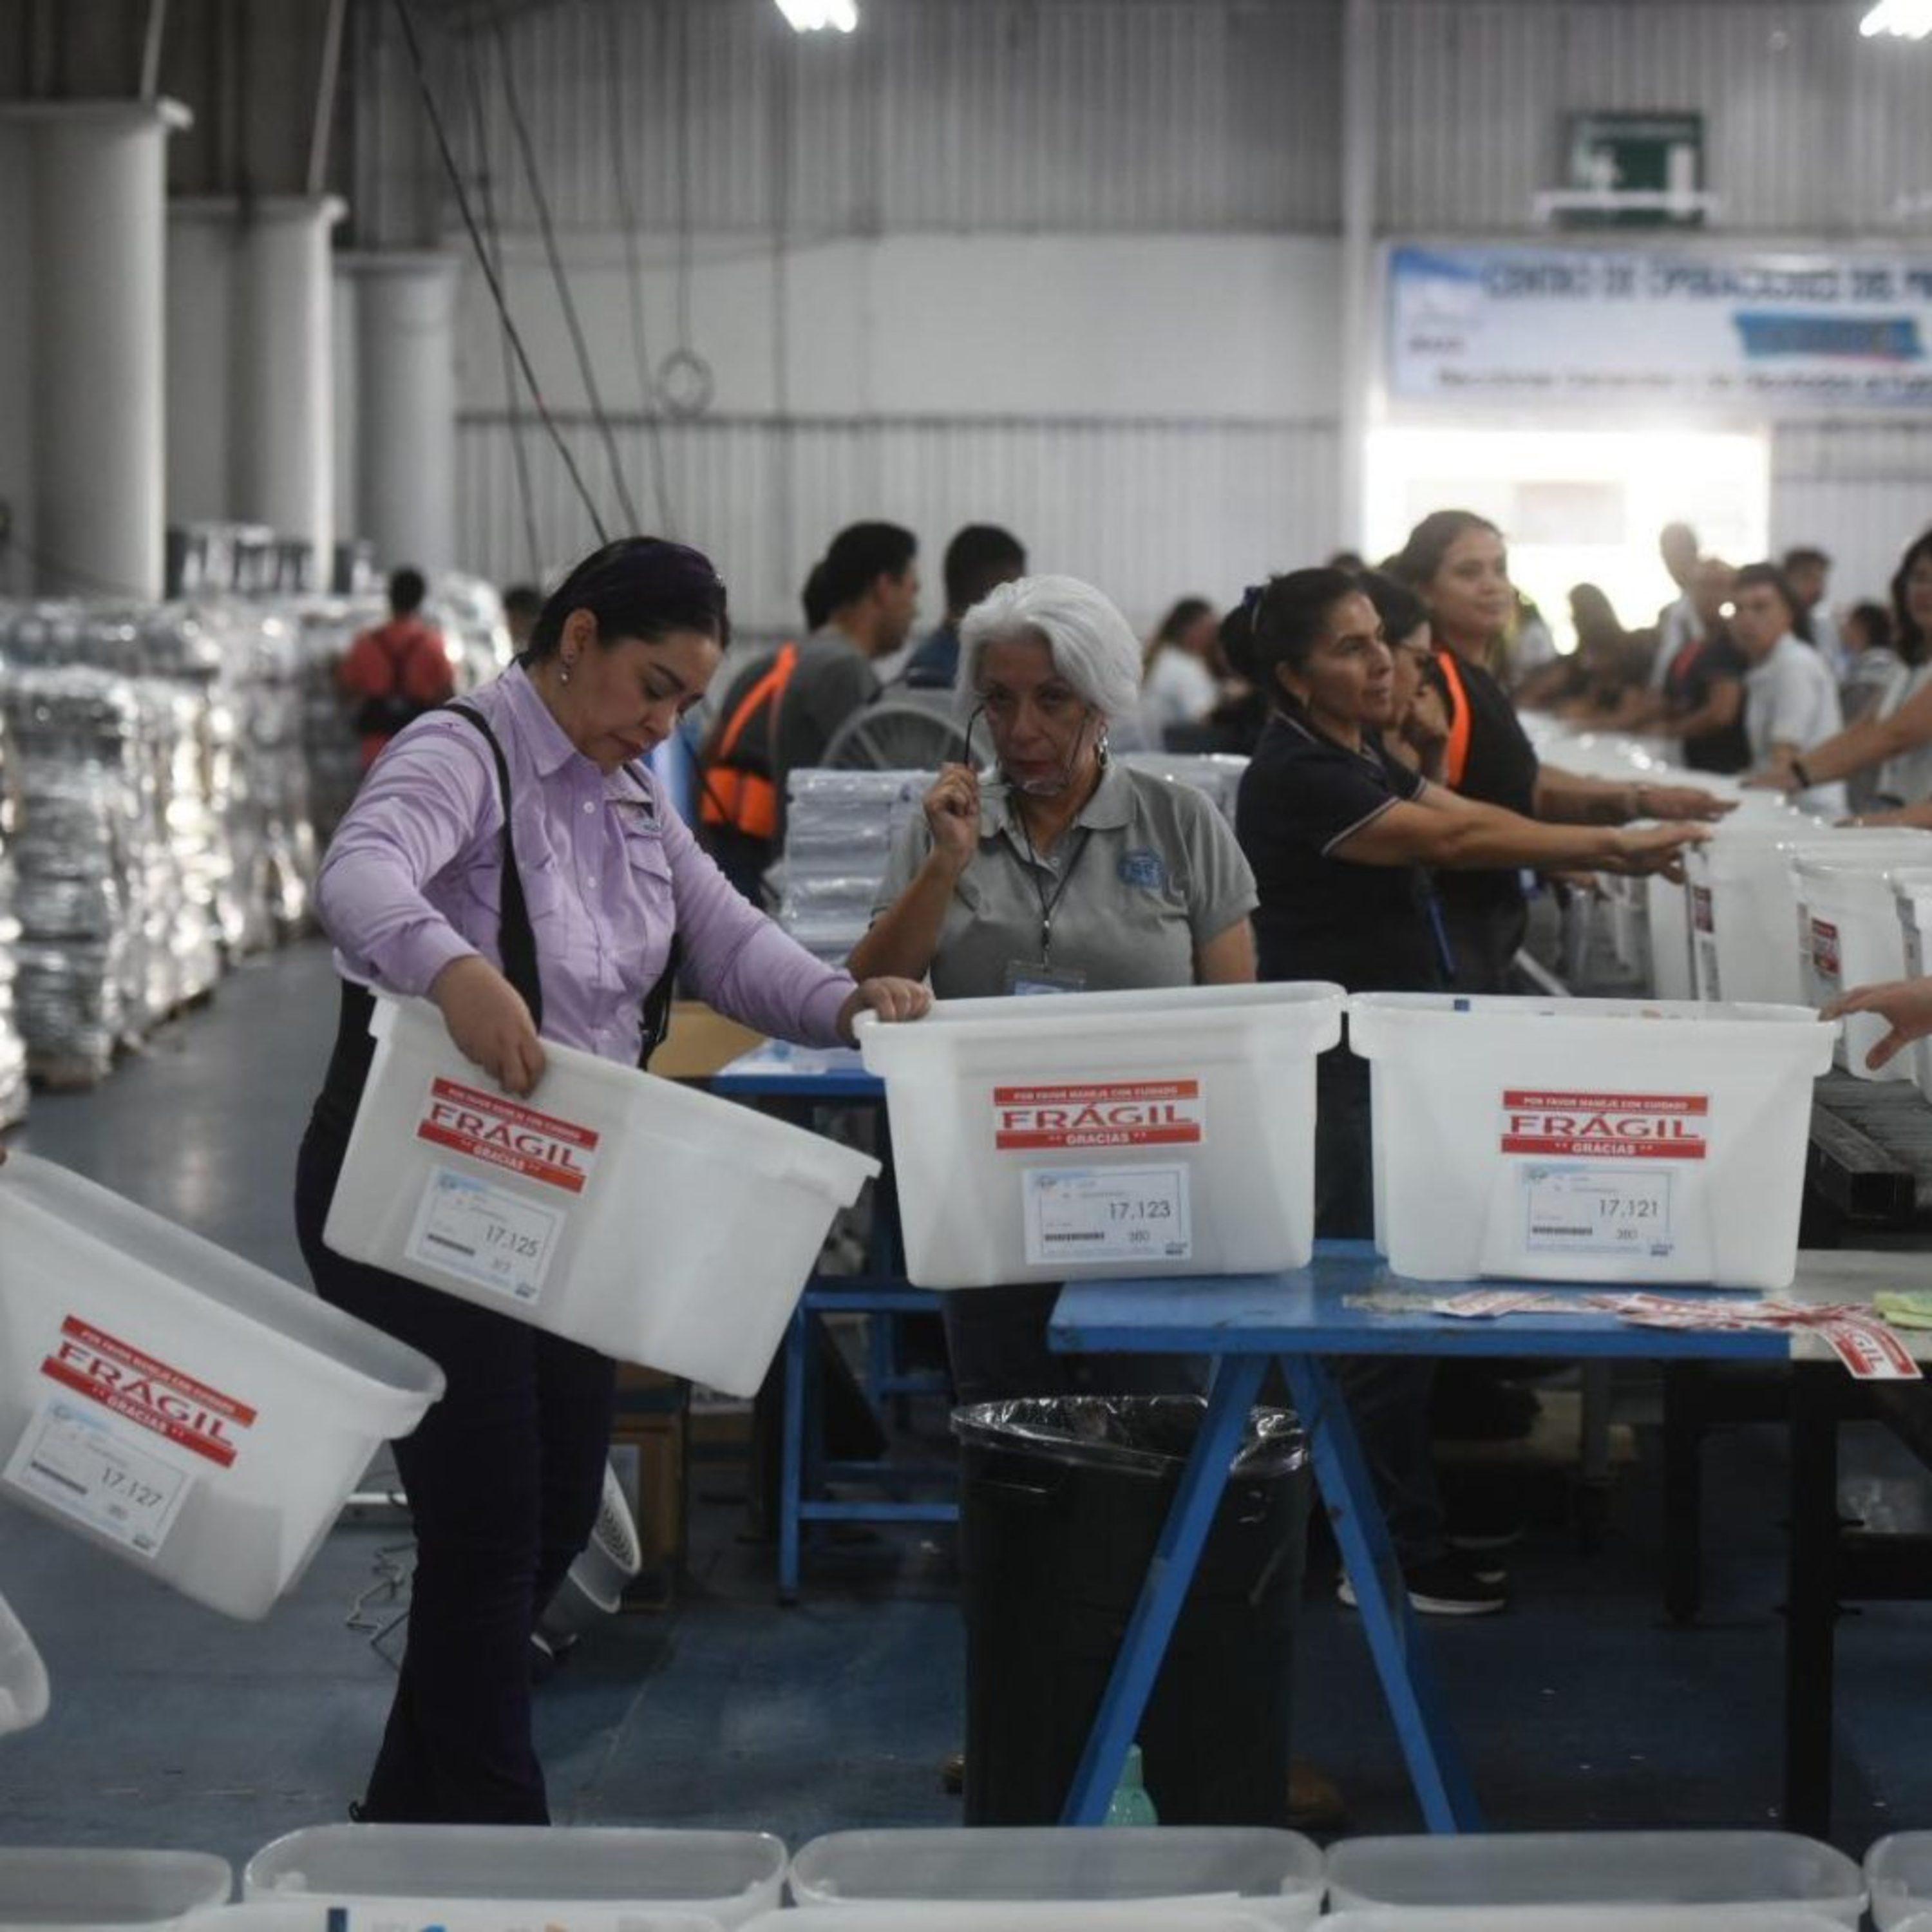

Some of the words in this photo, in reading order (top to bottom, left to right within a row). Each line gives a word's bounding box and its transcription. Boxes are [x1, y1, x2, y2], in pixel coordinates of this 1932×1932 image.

[1001, 1102, 1192, 1128] FRÁGIL
[1510, 1112, 1699, 1138] FRÁGIL
[431, 1104, 583, 1169] FRÁGIL
[1066, 1132, 1129, 1146] GRACIAS
[1572, 1143, 1636, 1155] GRACIAS
[473, 1144, 526, 1172] GRACIAS
[58, 1341, 233, 1448] FRÁGIL
[106, 1393, 169, 1434] GRACIAS
